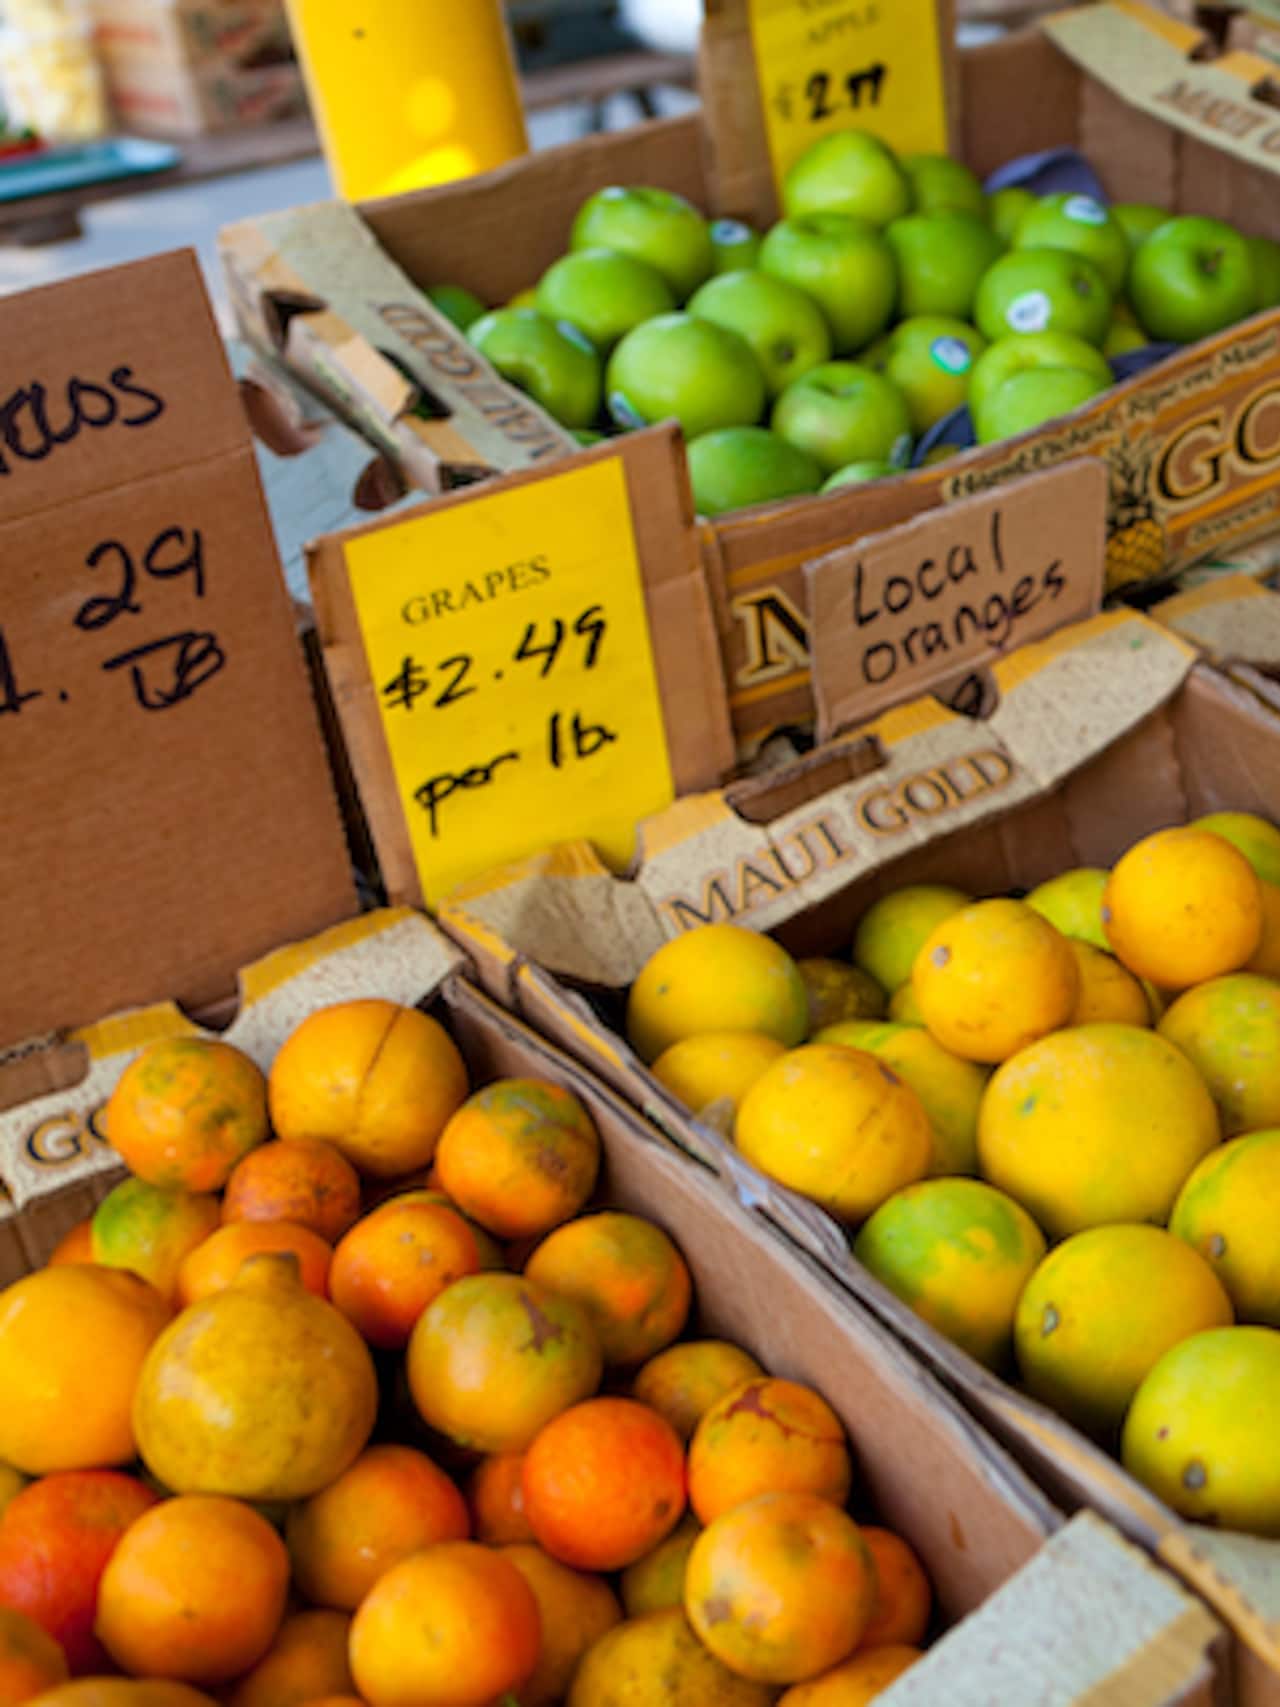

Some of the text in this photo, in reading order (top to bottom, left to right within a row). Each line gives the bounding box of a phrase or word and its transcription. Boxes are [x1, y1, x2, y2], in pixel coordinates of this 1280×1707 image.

[400, 554, 552, 626] GRAPES
[852, 510, 1005, 630] Local
[860, 560, 1067, 684] oranges
[382, 604, 606, 712] $2.49
[664, 750, 1014, 932] MAUI GOLD
